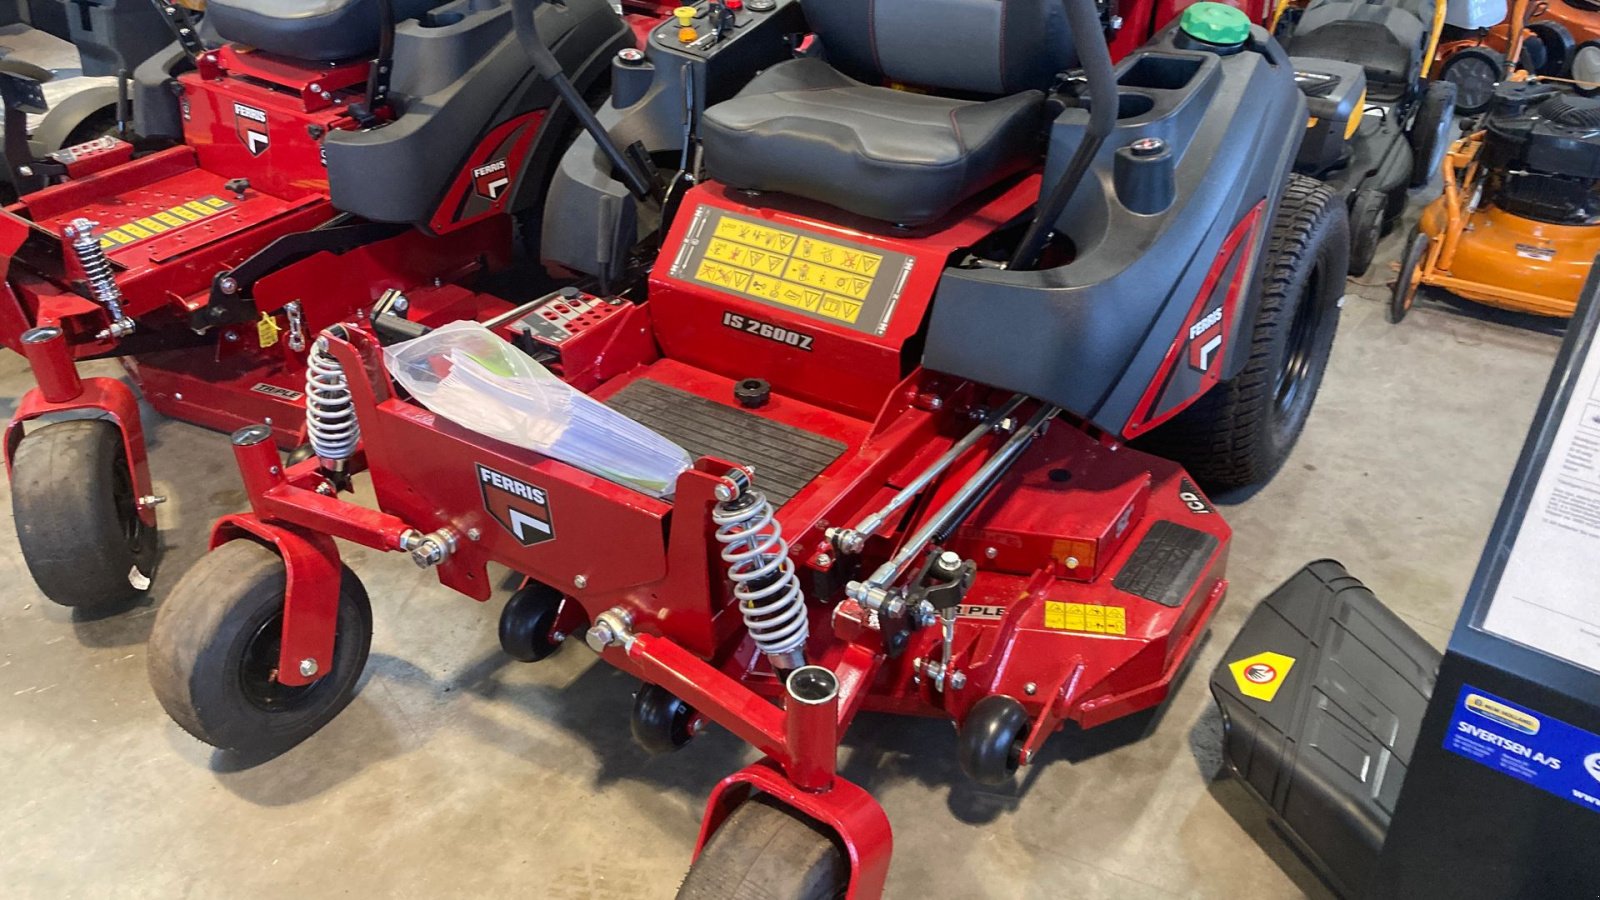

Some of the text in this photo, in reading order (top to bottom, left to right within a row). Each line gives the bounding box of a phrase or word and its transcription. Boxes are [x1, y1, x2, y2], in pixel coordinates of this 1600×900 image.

[234, 103, 266, 122] FERRIS
[473, 160, 506, 178] FERRIS
[723, 312, 813, 351] IS 2600Z
[1189, 307, 1223, 340] FERRIS
[479, 467, 546, 505] FERRIS
[1457, 721, 1533, 759] SIVERTSEN
[1532, 752, 1562, 770] A/S
